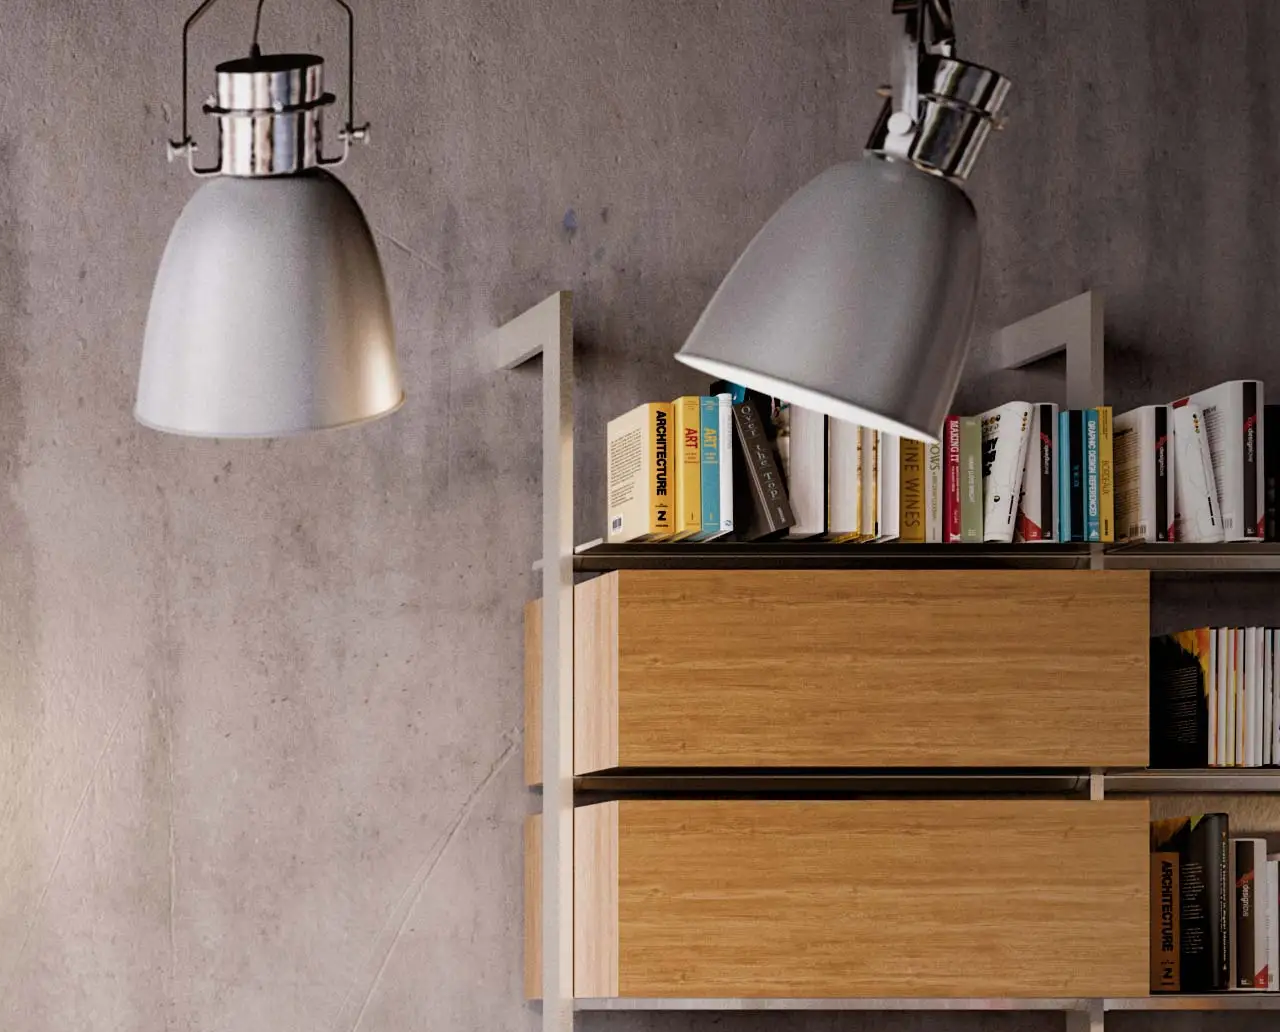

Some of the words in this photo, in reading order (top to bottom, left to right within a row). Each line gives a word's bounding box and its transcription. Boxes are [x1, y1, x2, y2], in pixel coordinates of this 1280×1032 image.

[685, 428, 699, 449] ART
[704, 428, 717, 449] ART
[950, 420, 959, 453] MAKING
[1088, 420, 1096, 449] GRAPHIC
[655, 410, 667, 496] ARCHITECTURE
[950, 454, 959, 462] IT
[1088, 450, 1096, 474] DESIGN
[904, 478, 920, 528] WINES
[1089, 475, 1097, 517] REFERENCED
[1161, 860, 1174, 953] ARCHITECTURE
